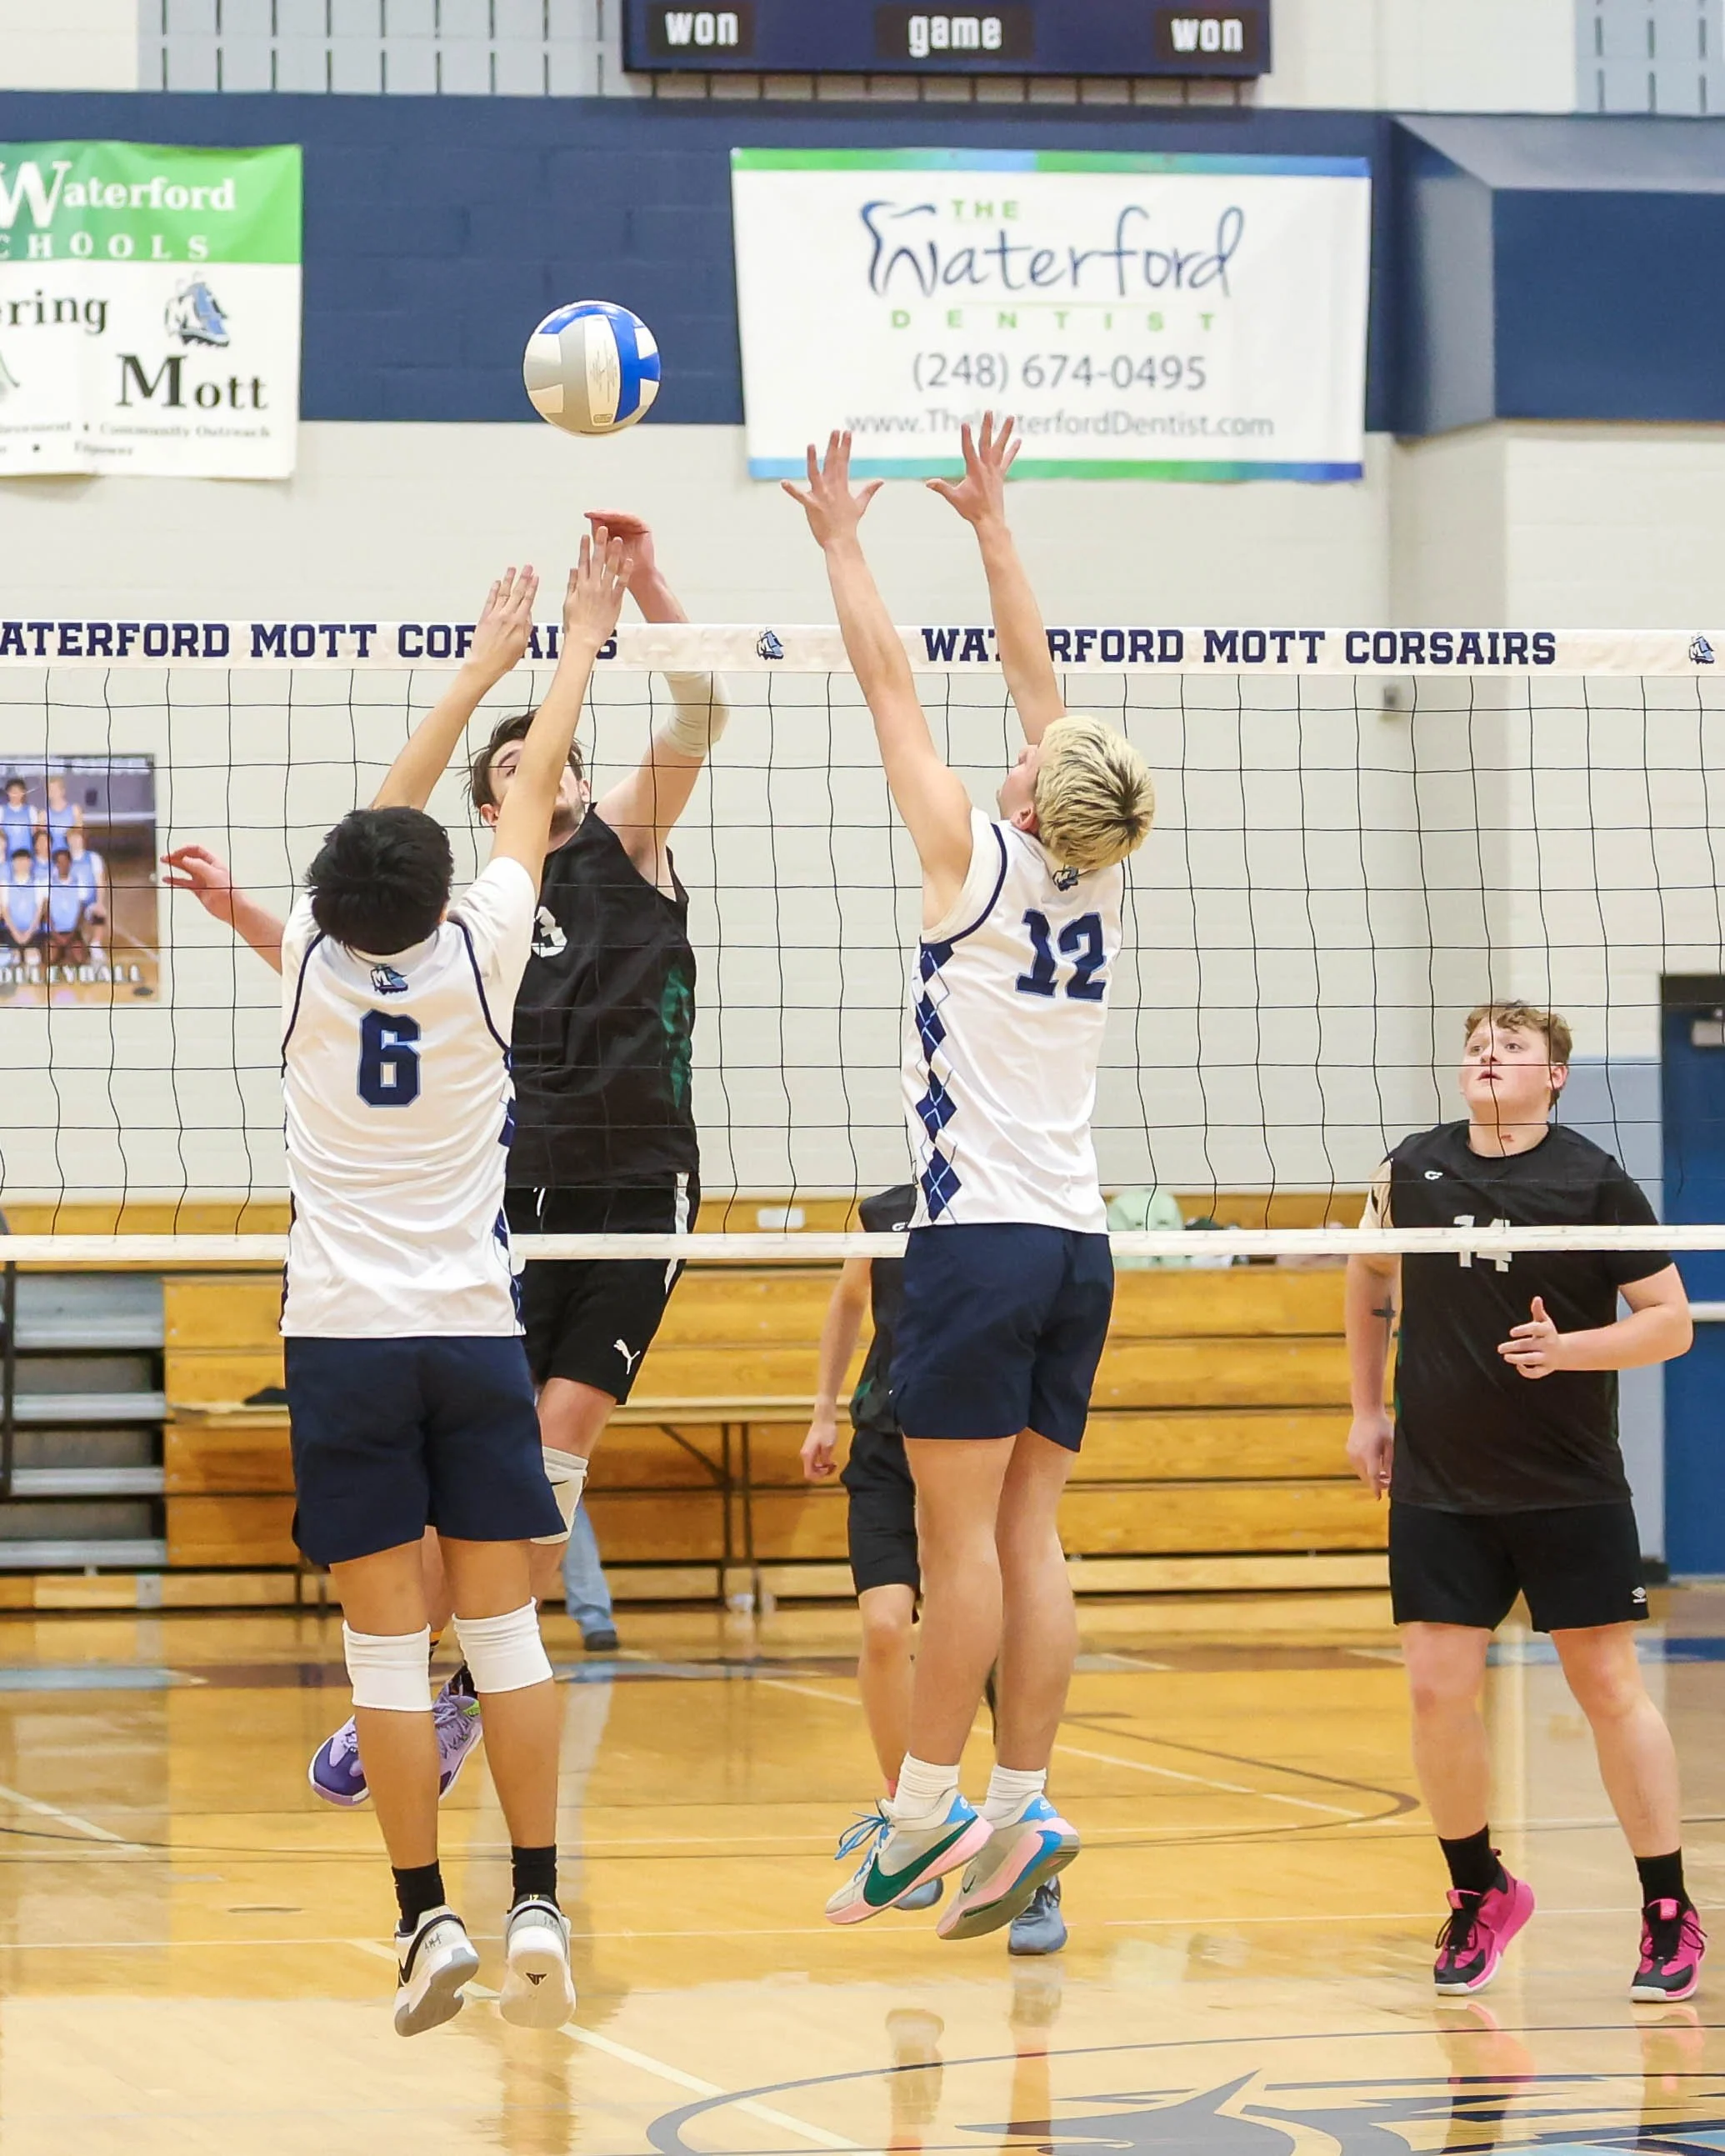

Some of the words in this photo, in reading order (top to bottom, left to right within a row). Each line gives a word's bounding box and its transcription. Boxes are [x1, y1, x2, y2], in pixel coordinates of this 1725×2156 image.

[665, 12, 738, 47] won
[908, 15, 1002, 58] game
[1170, 17, 1243, 53] won
[0, 160, 236, 228] Waterford
[952, 199, 1020, 220] THE
[861, 200, 1244, 298] Waterford
[0, 288, 109, 337] ring
[891, 308, 1214, 332] DENTIST
[116, 353, 268, 410] Mott
[912, 350, 1009, 393] (248)
[1022, 353, 1207, 390] 674-0495
[252, 623, 378, 658] MOTT
[398, 623, 618, 660] CORAIS
[921, 628, 1184, 663] WARFORD
[1203, 629, 1327, 665] MOTT
[1346, 631, 1557, 666] CORSAIRS
[1016, 908, 1108, 1003] 12
[357, 1008, 421, 1108] 6
[1453, 1214, 1512, 1273] 14
